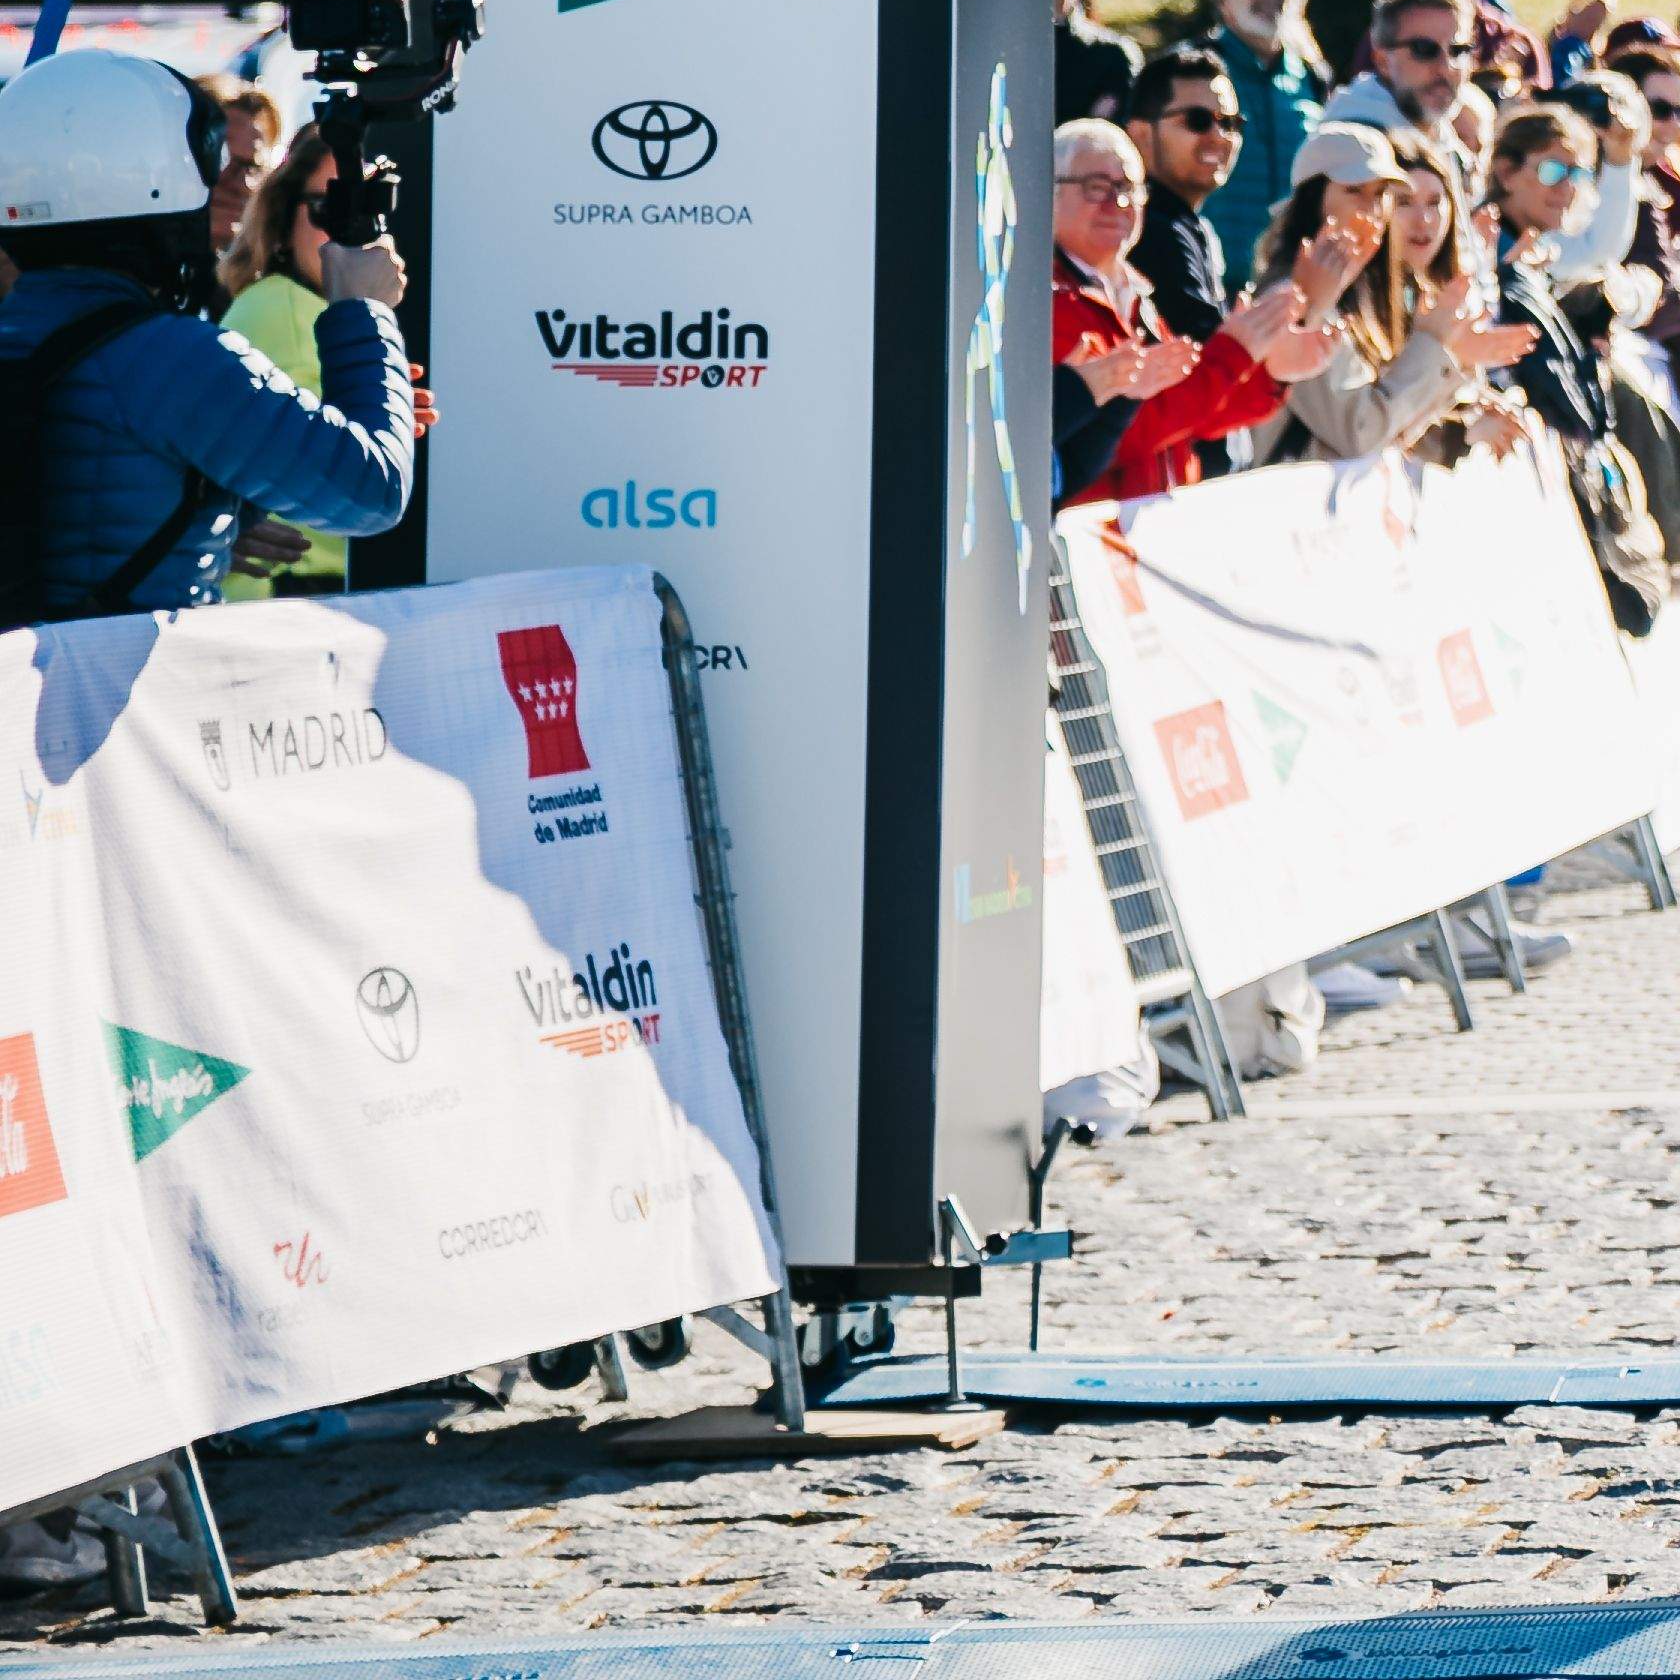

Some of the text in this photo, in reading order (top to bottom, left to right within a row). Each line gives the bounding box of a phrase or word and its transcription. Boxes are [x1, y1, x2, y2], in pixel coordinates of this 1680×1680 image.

[553, 204, 753, 225] SUPRA GAMBOA
[535, 308, 769, 360] Vitaldin
[659, 365, 768, 389] SPORT
[581, 480, 718, 529] alsa
[249, 707, 387, 778] MADRID
[527, 783, 603, 815] Comunidad
[533, 810, 609, 845] de Madrid
[515, 942, 658, 1028] Vitaldin
